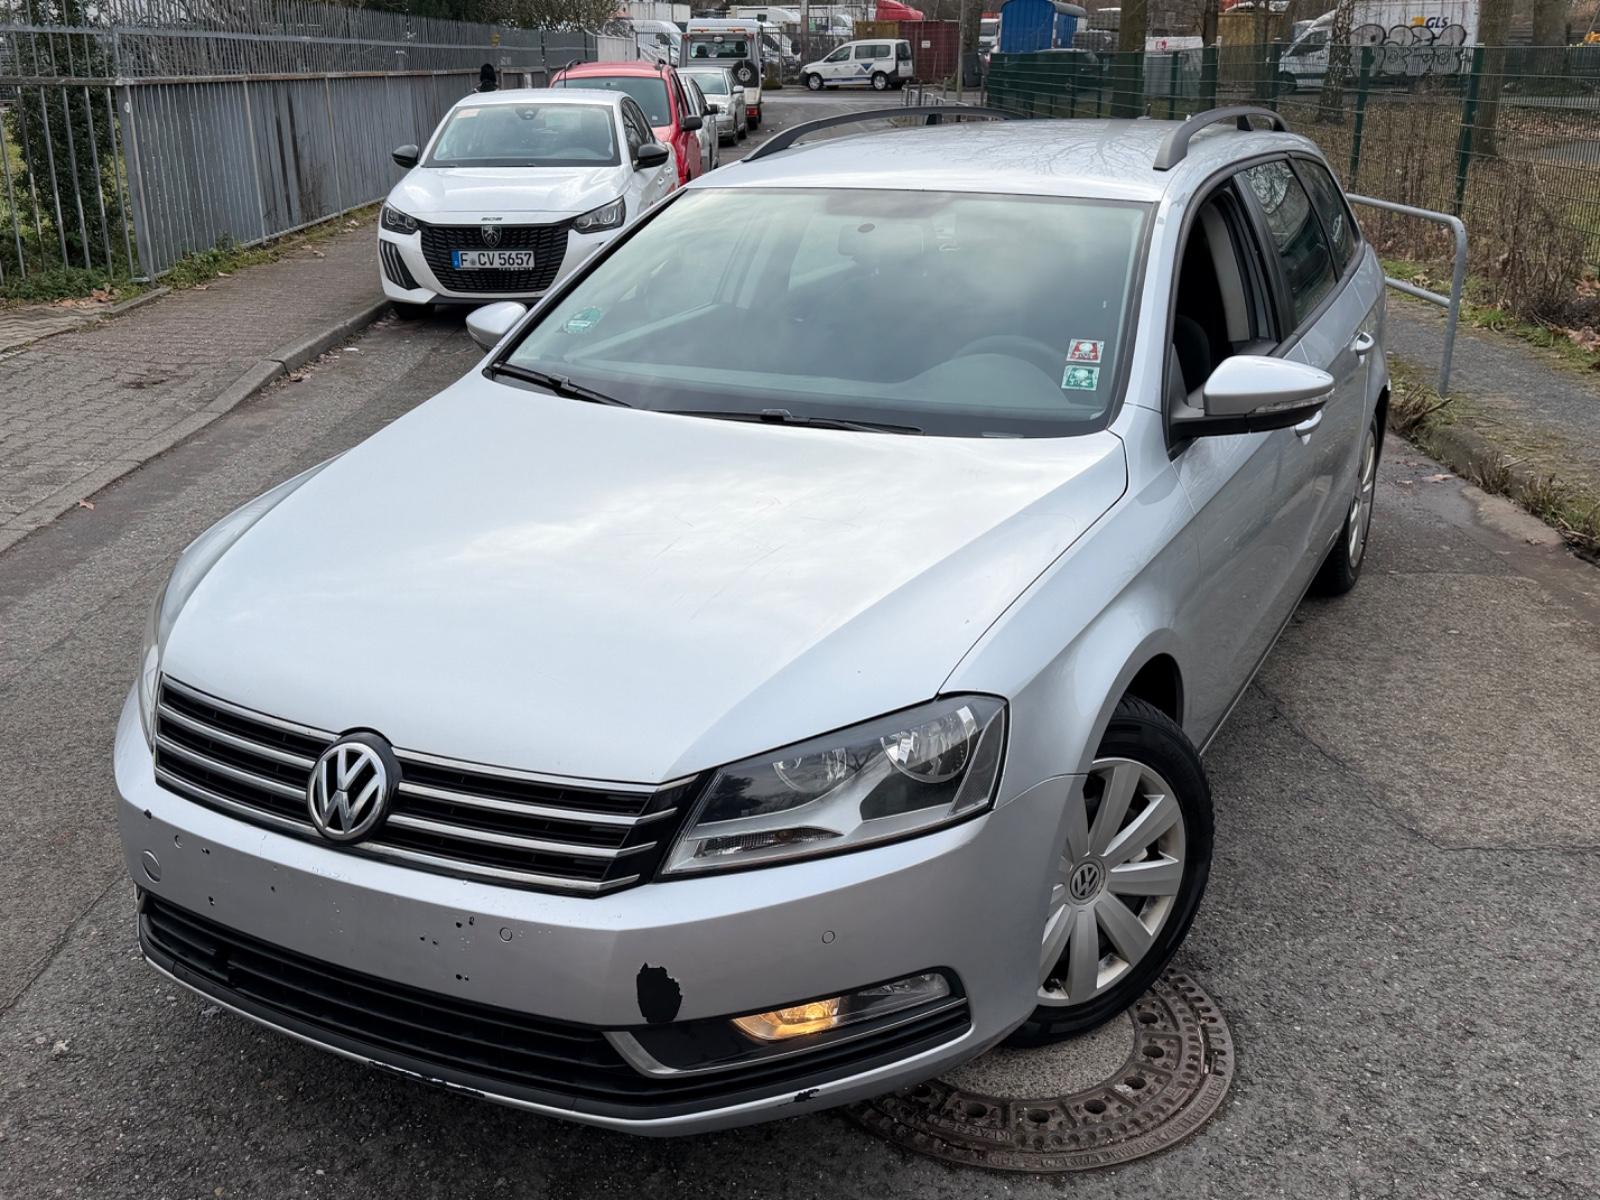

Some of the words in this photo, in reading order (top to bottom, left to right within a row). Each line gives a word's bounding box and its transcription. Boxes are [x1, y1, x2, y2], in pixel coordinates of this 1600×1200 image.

[1426, 16, 1449, 29] GLS
[460, 252, 468, 266] F
[478, 252, 495, 266] CV
[498, 252, 532, 267] 5657
